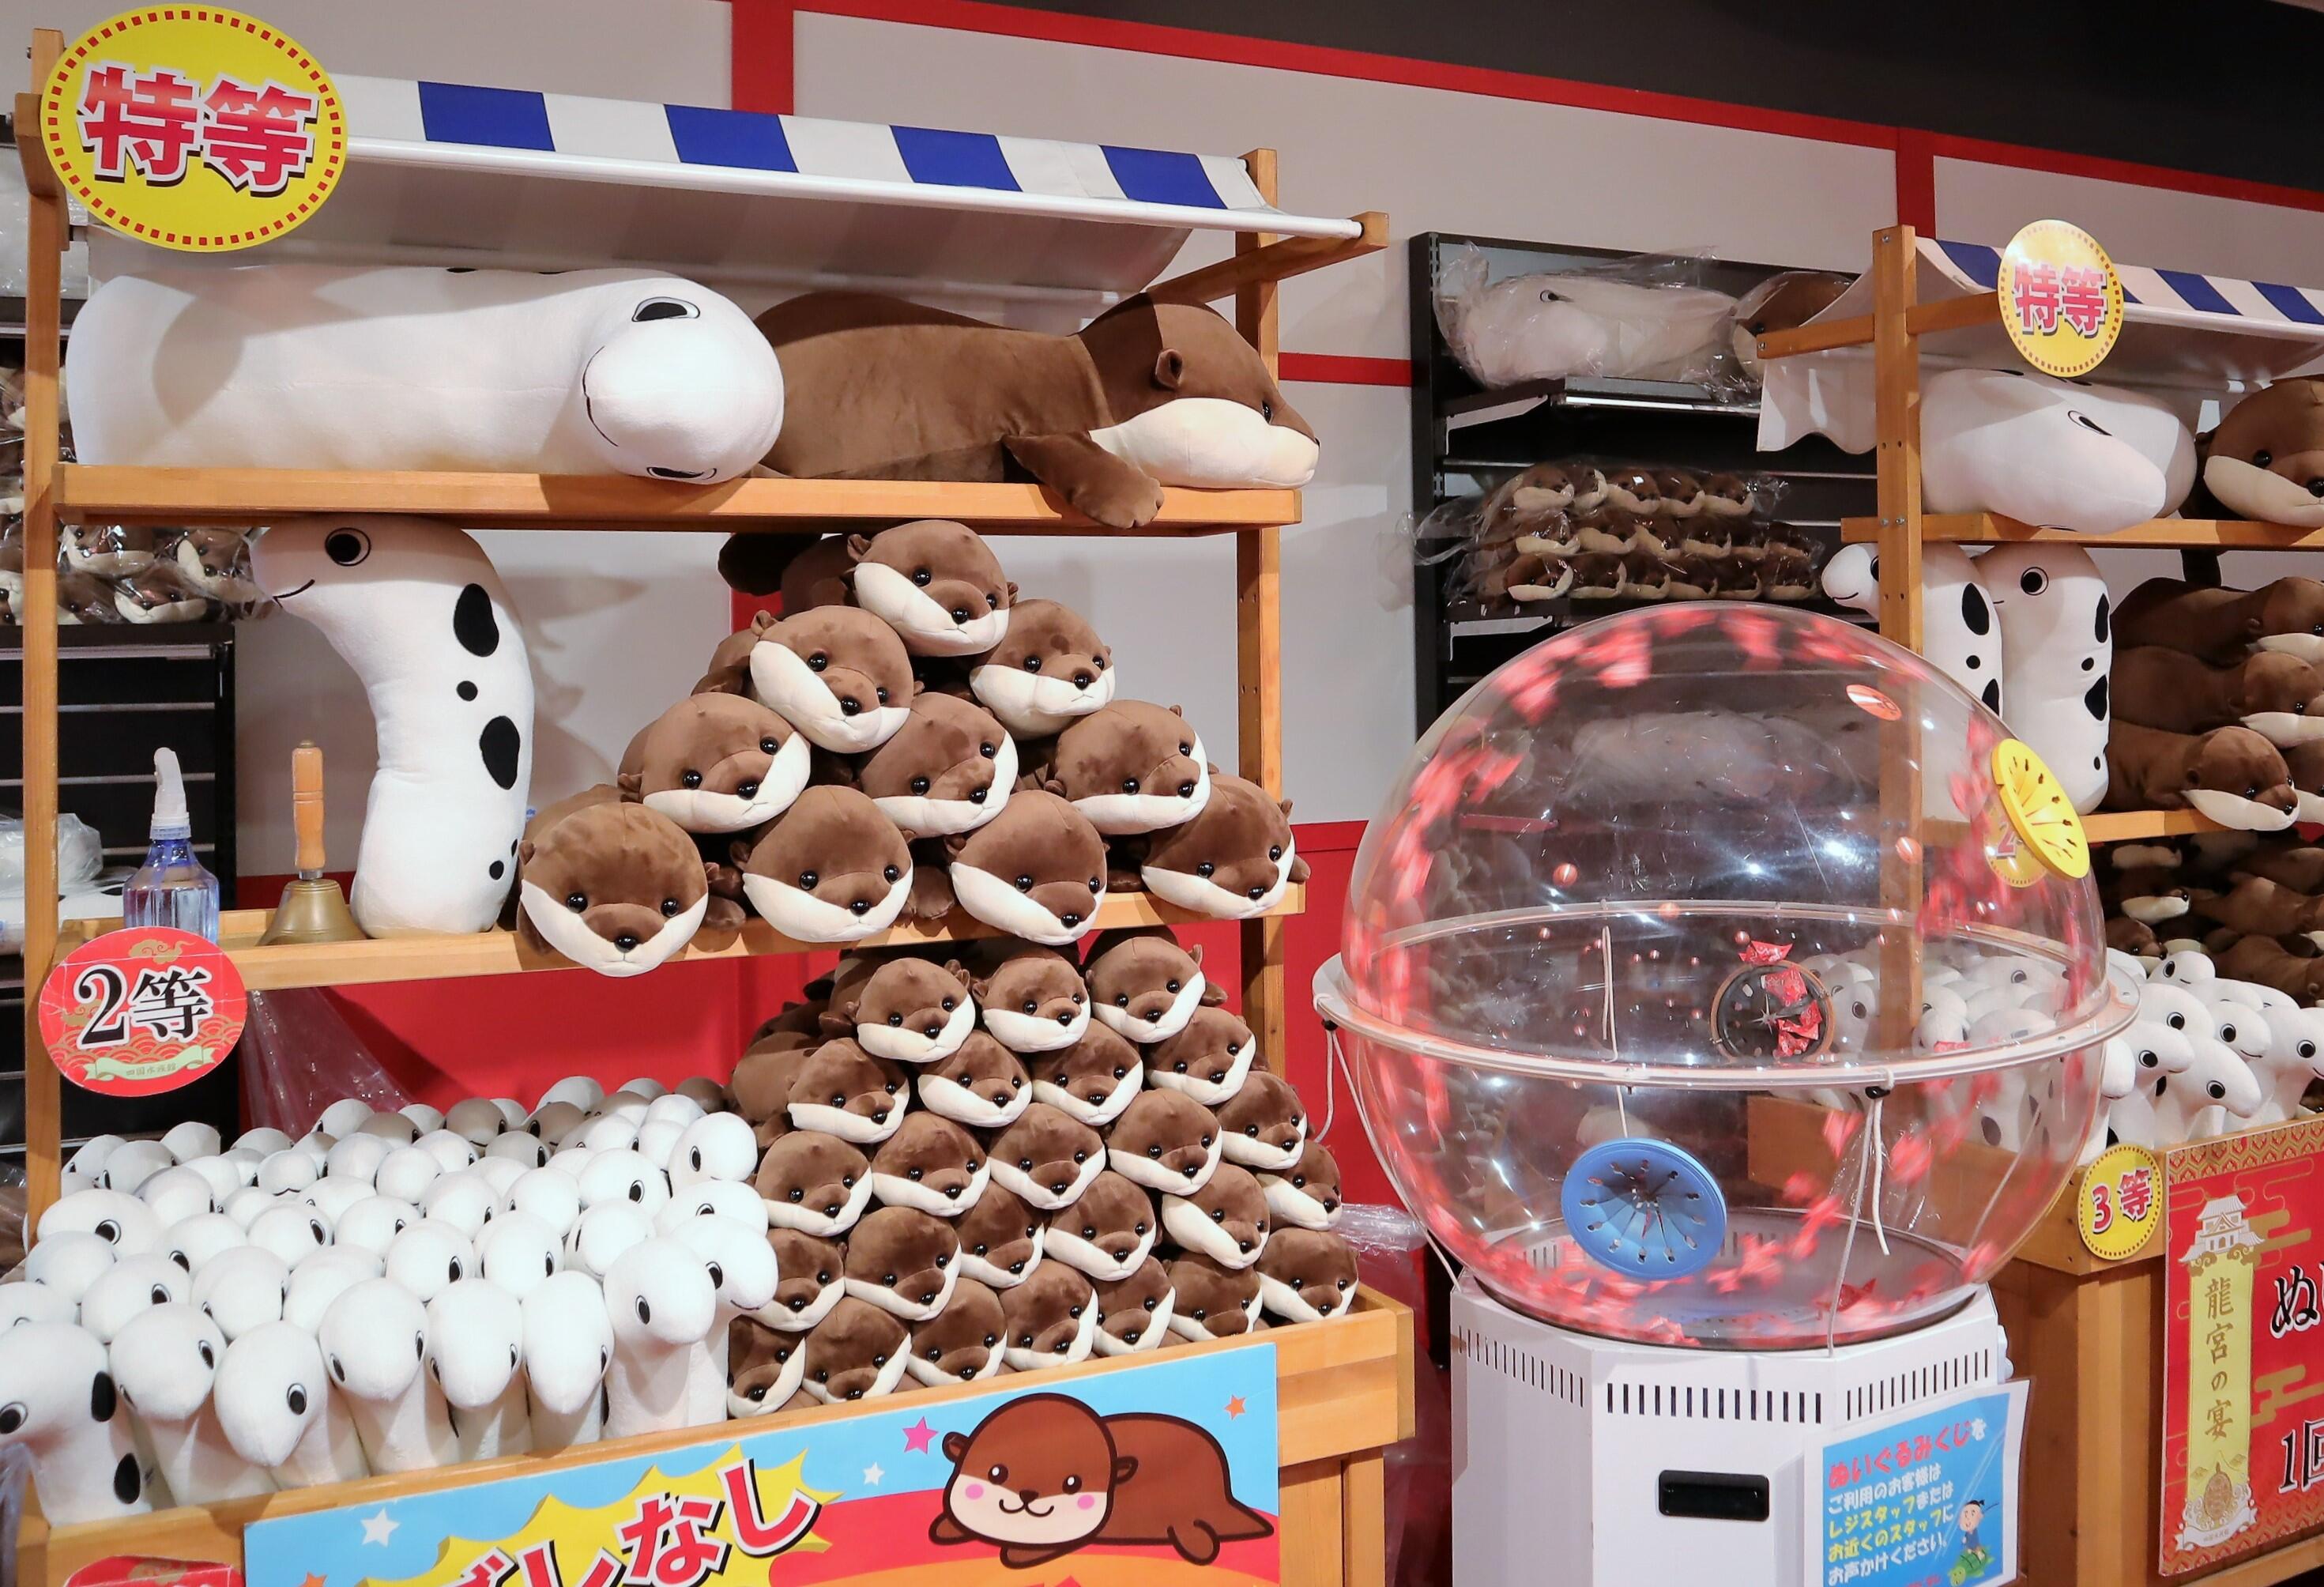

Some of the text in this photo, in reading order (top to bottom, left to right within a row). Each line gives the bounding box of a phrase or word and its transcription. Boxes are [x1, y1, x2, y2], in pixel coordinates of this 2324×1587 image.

[79, 62, 318, 194] 特等
[2013, 263, 2107, 337] 特等
[75, 965, 213, 1048] 2等
[2091, 1167, 2153, 1235] 3等
[2270, 1261, 2324, 1338] ぬ
[2204, 1276, 2235, 1442] 龍宮の宴
[1828, 1463, 1942, 1515] ご利用のお客様は
[1829, 1418, 1987, 1489] ぬいぐるみくじを
[1828, 1504, 1954, 1562] お近くのスタッフに
[1829, 1480, 1954, 1540] レジスタッフまたは
